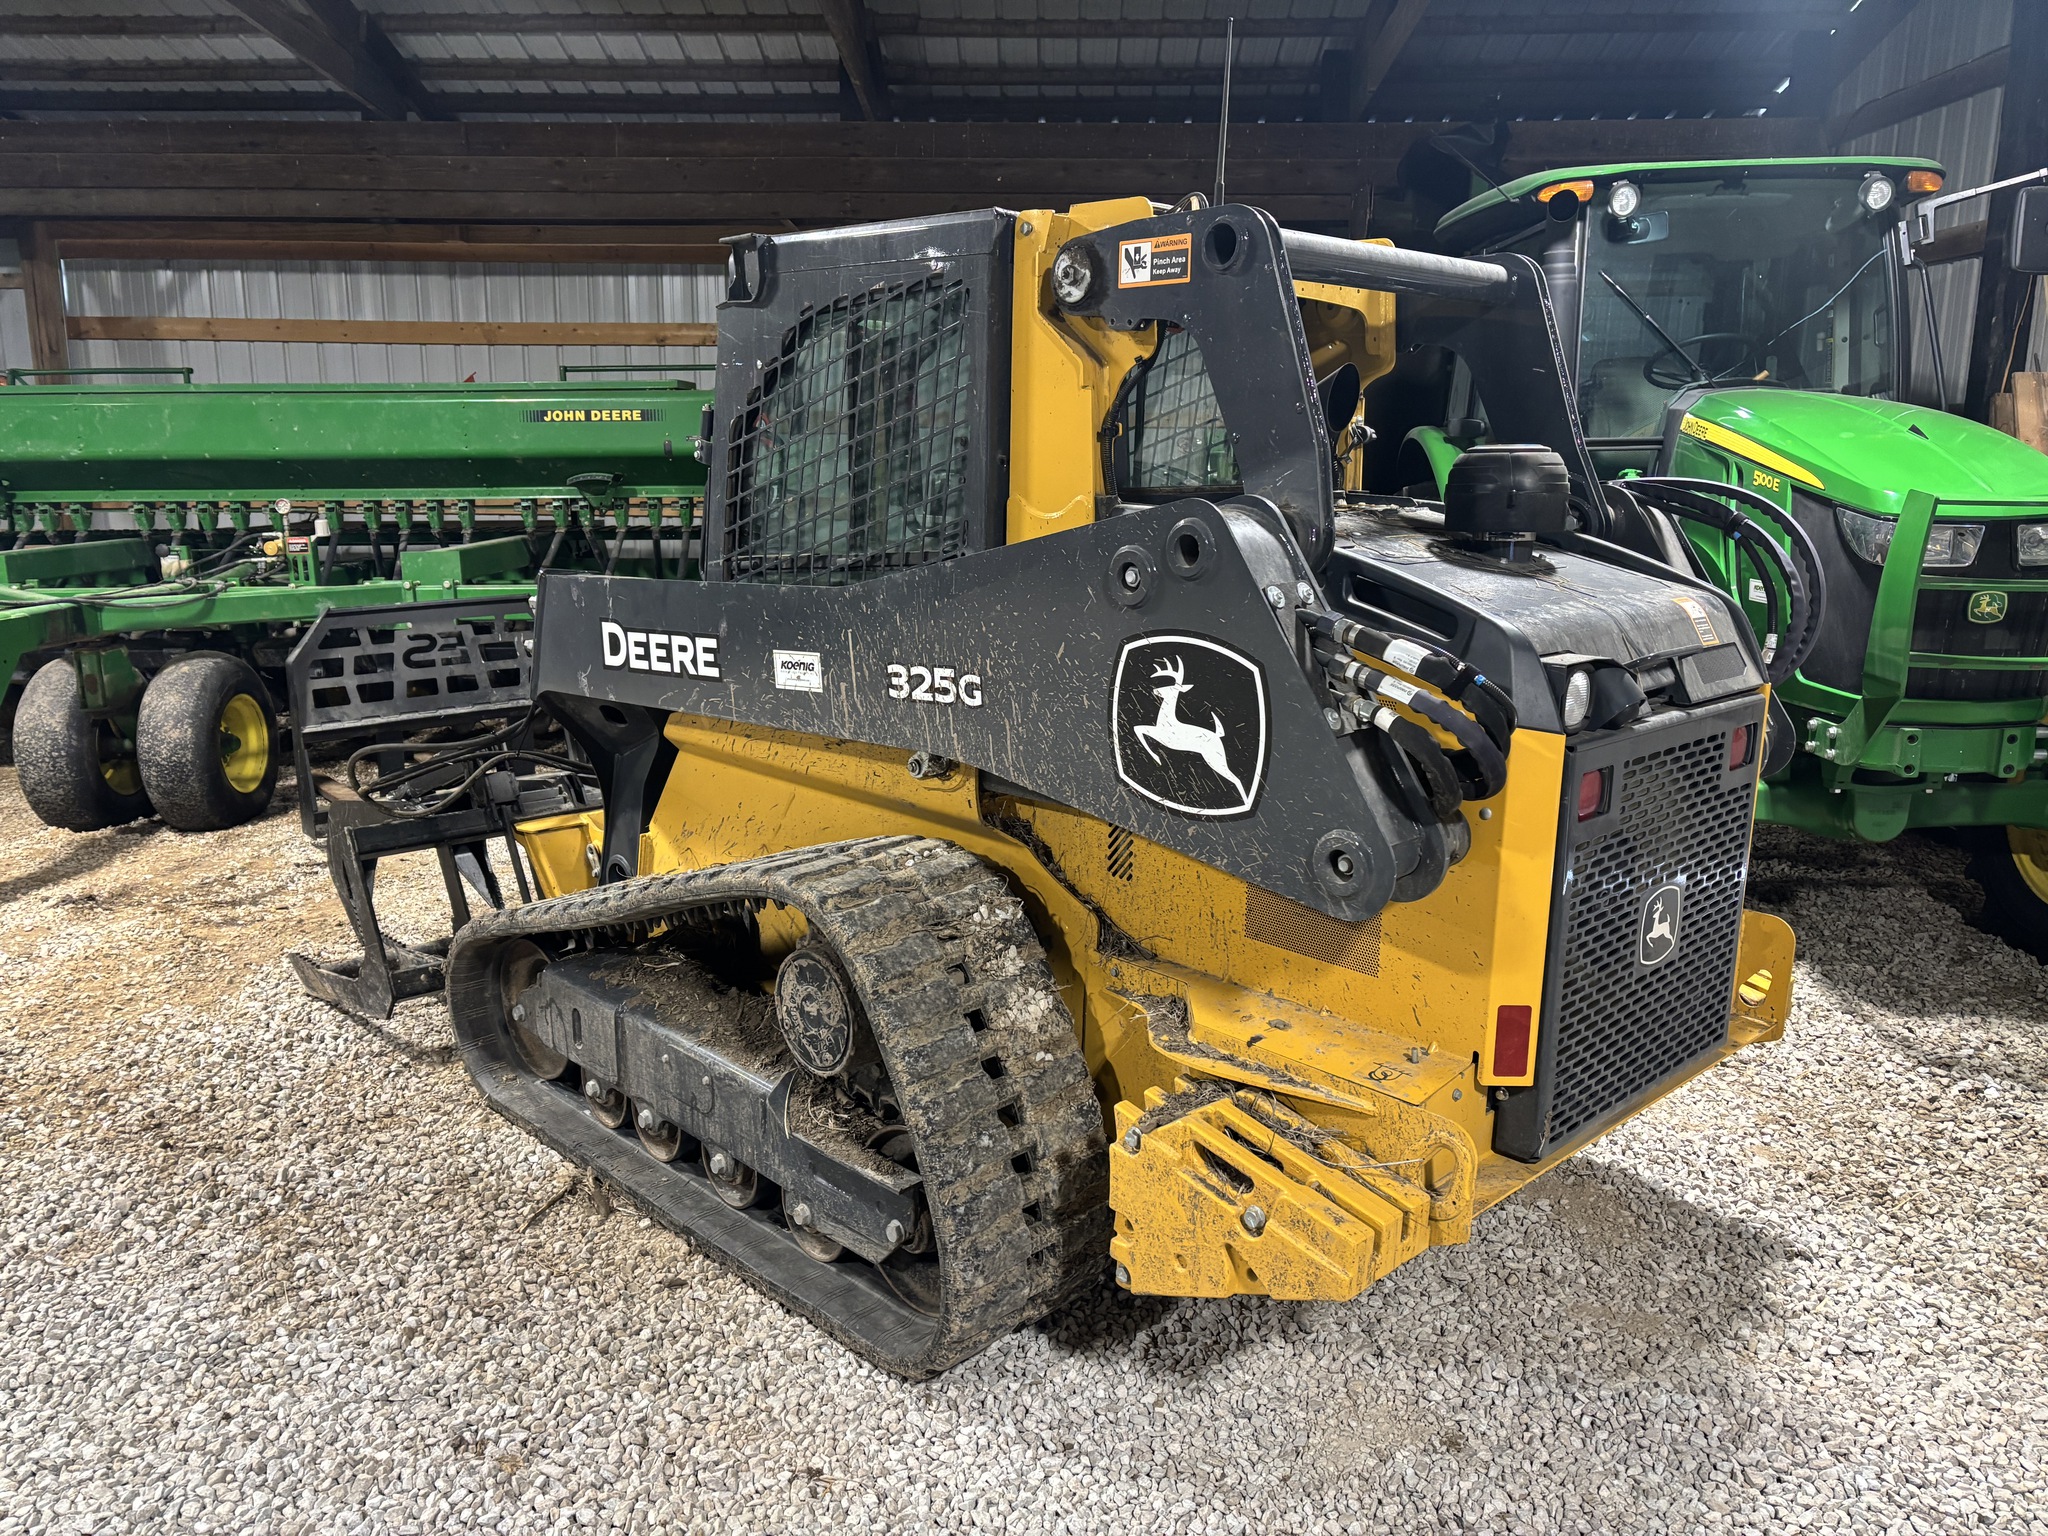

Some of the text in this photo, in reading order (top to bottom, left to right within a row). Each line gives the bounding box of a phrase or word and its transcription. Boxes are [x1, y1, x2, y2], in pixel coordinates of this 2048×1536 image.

[1160, 238, 1187, 248] WARNING
[1153, 256, 1186, 266] Pinch Area
[1152, 268, 1166, 276] Keep
[543, 410, 642, 422] JOHN DEERE
[601, 621, 720, 678] DEERE
[887, 664, 983, 707] 325G
